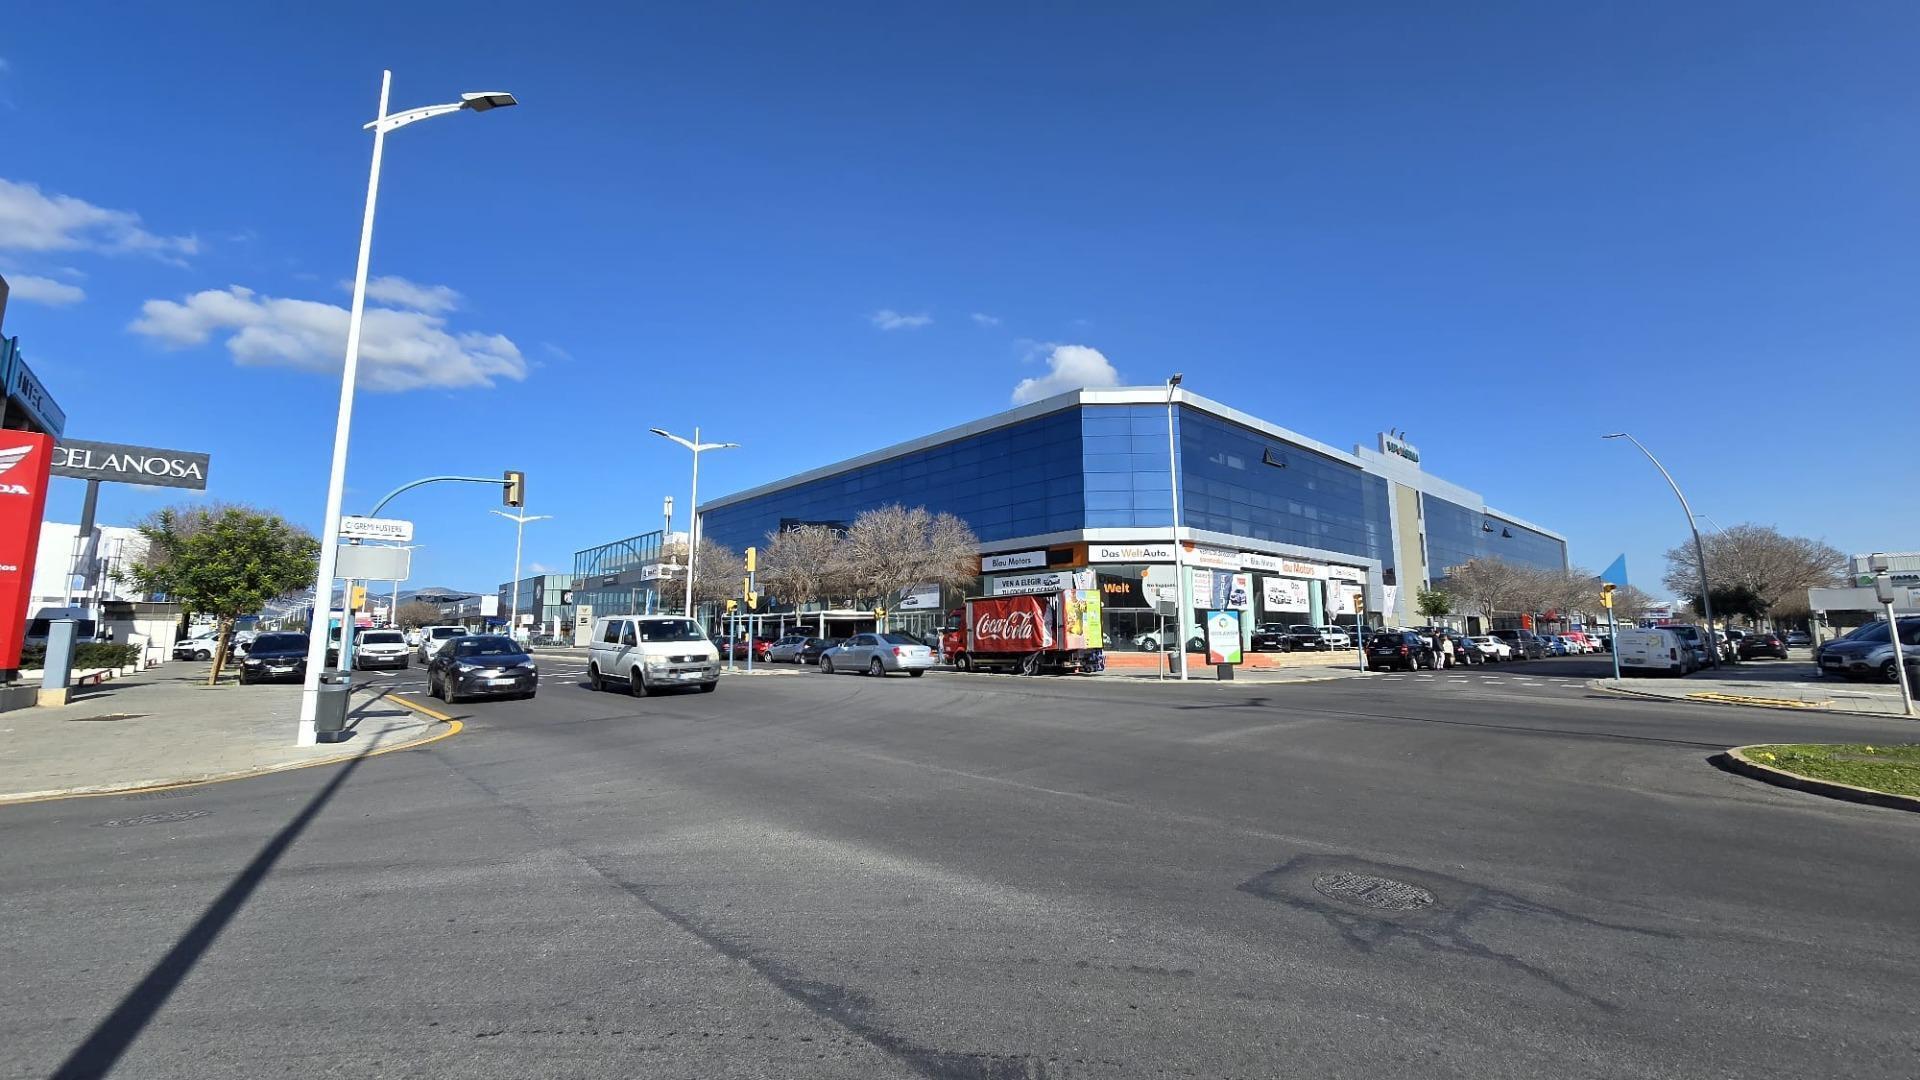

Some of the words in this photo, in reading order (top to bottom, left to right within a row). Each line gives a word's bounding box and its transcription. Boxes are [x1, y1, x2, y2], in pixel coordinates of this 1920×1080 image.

[1101, 549, 1120, 558] Das
[992, 558, 1007, 567] Blau
[1008, 557, 1031, 566] Motors
[1293, 562, 1315, 576] Motors
[1021, 578, 1041, 586] ELEGIR
[1104, 582, 1130, 593] Welt
